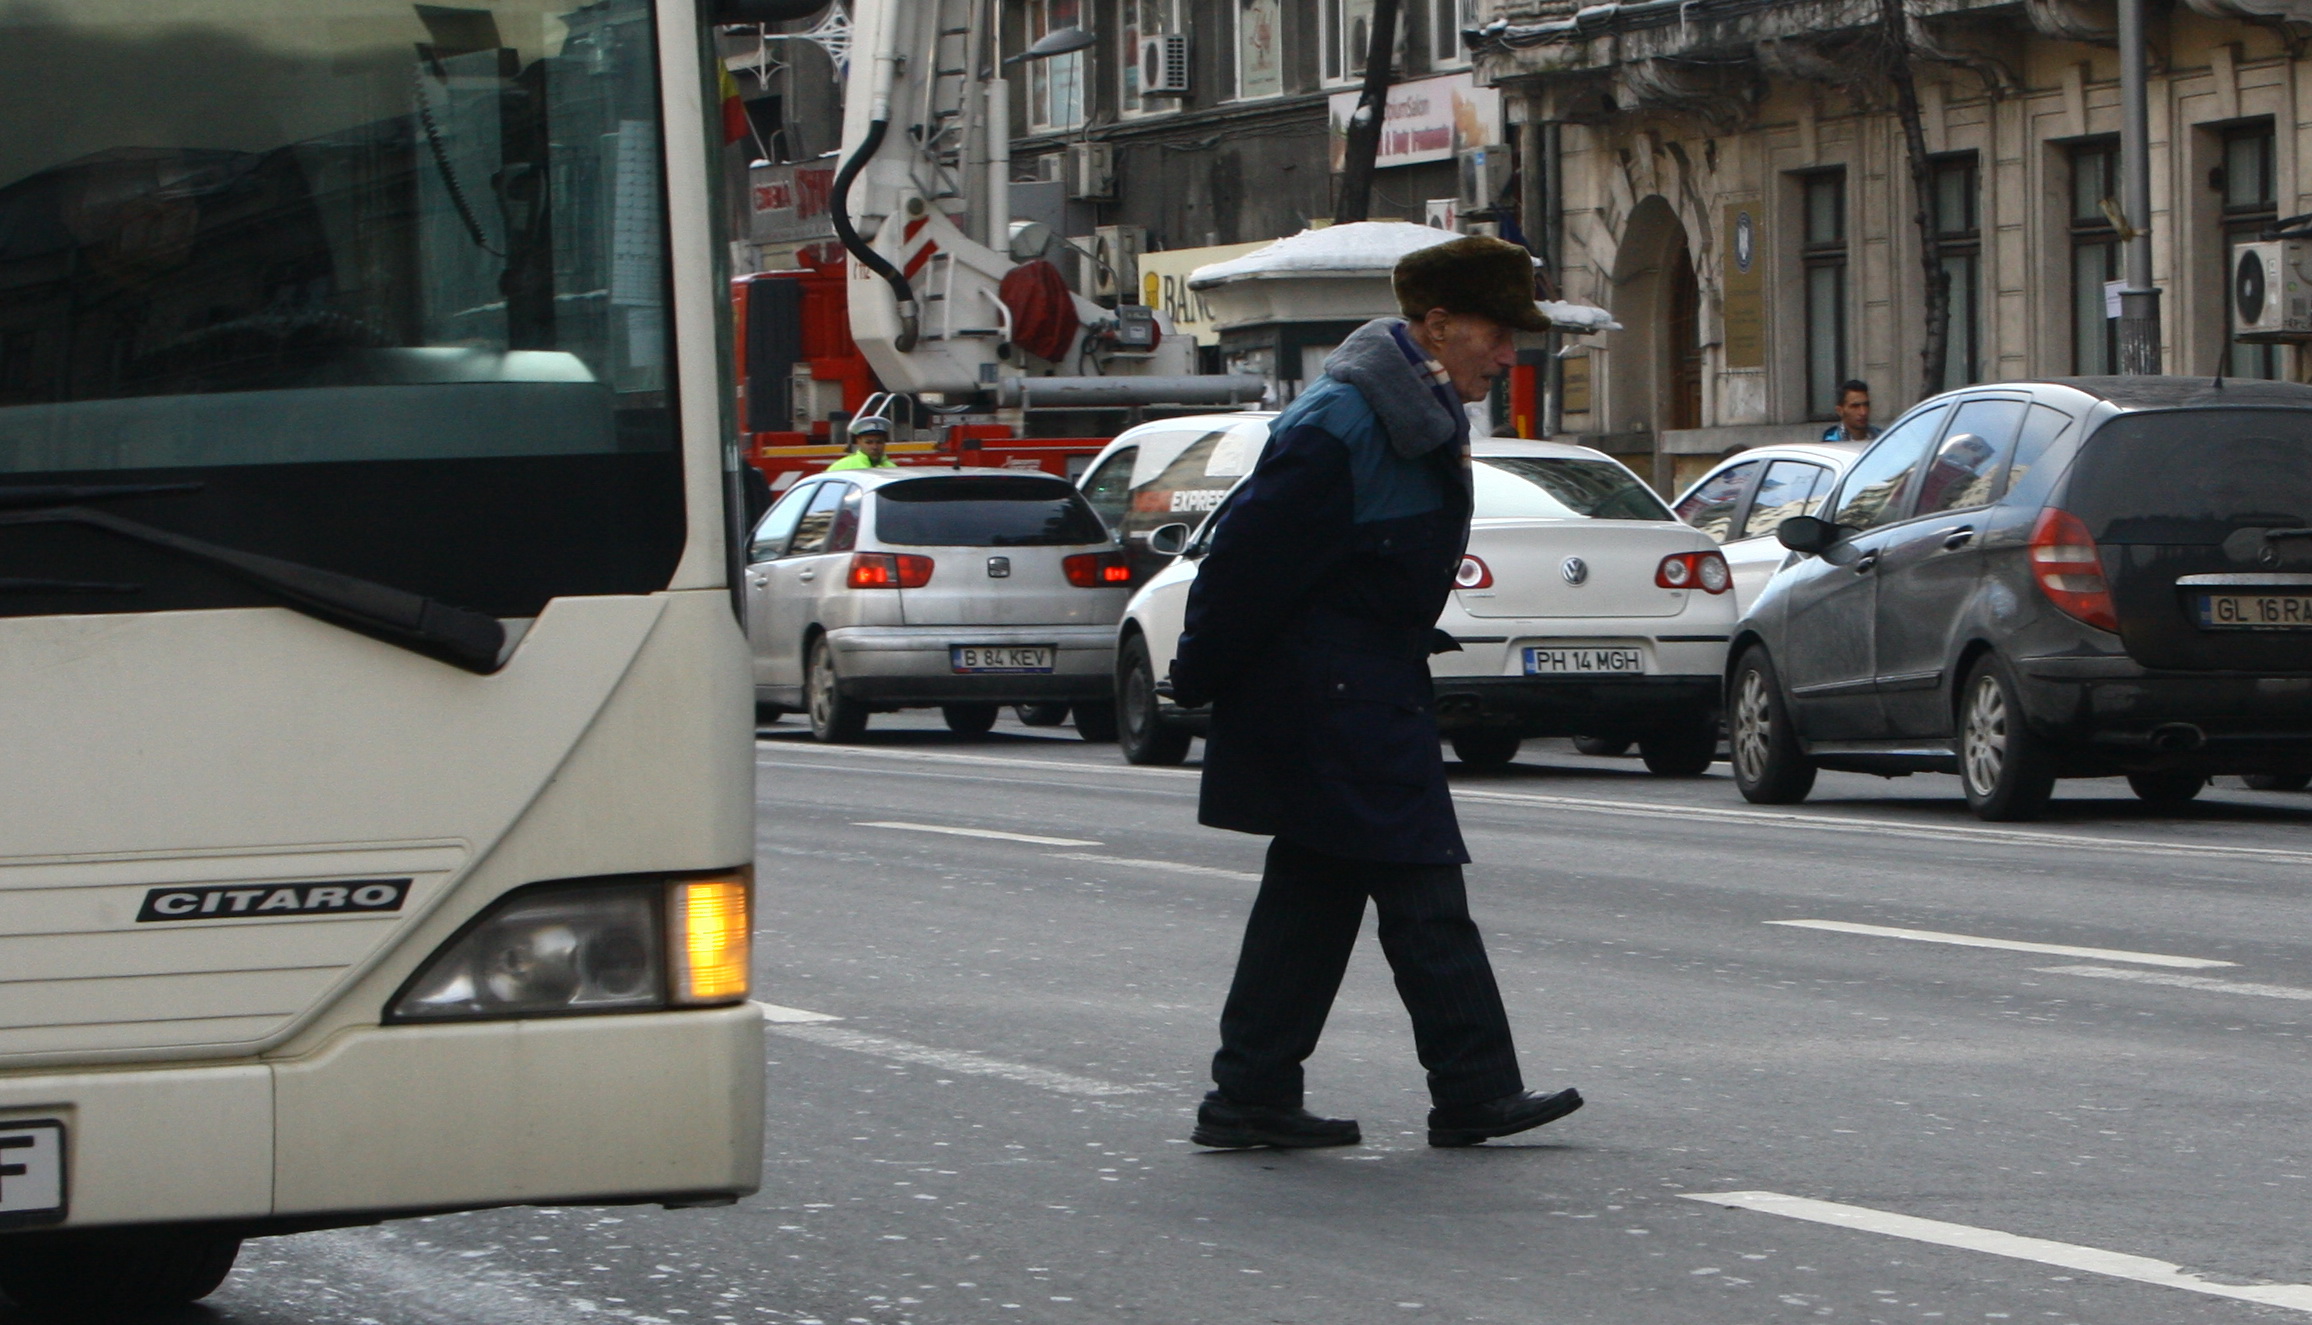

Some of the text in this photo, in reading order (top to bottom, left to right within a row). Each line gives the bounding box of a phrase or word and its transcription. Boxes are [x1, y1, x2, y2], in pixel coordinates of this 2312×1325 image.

[2217, 598, 2248, 621] GL
[2257, 598, 2279, 621] 16
[965, 650, 1045, 666] B 84 KEV
[1537, 651, 1639, 671] PH 14 MGH
[153, 884, 399, 915] CITARO
